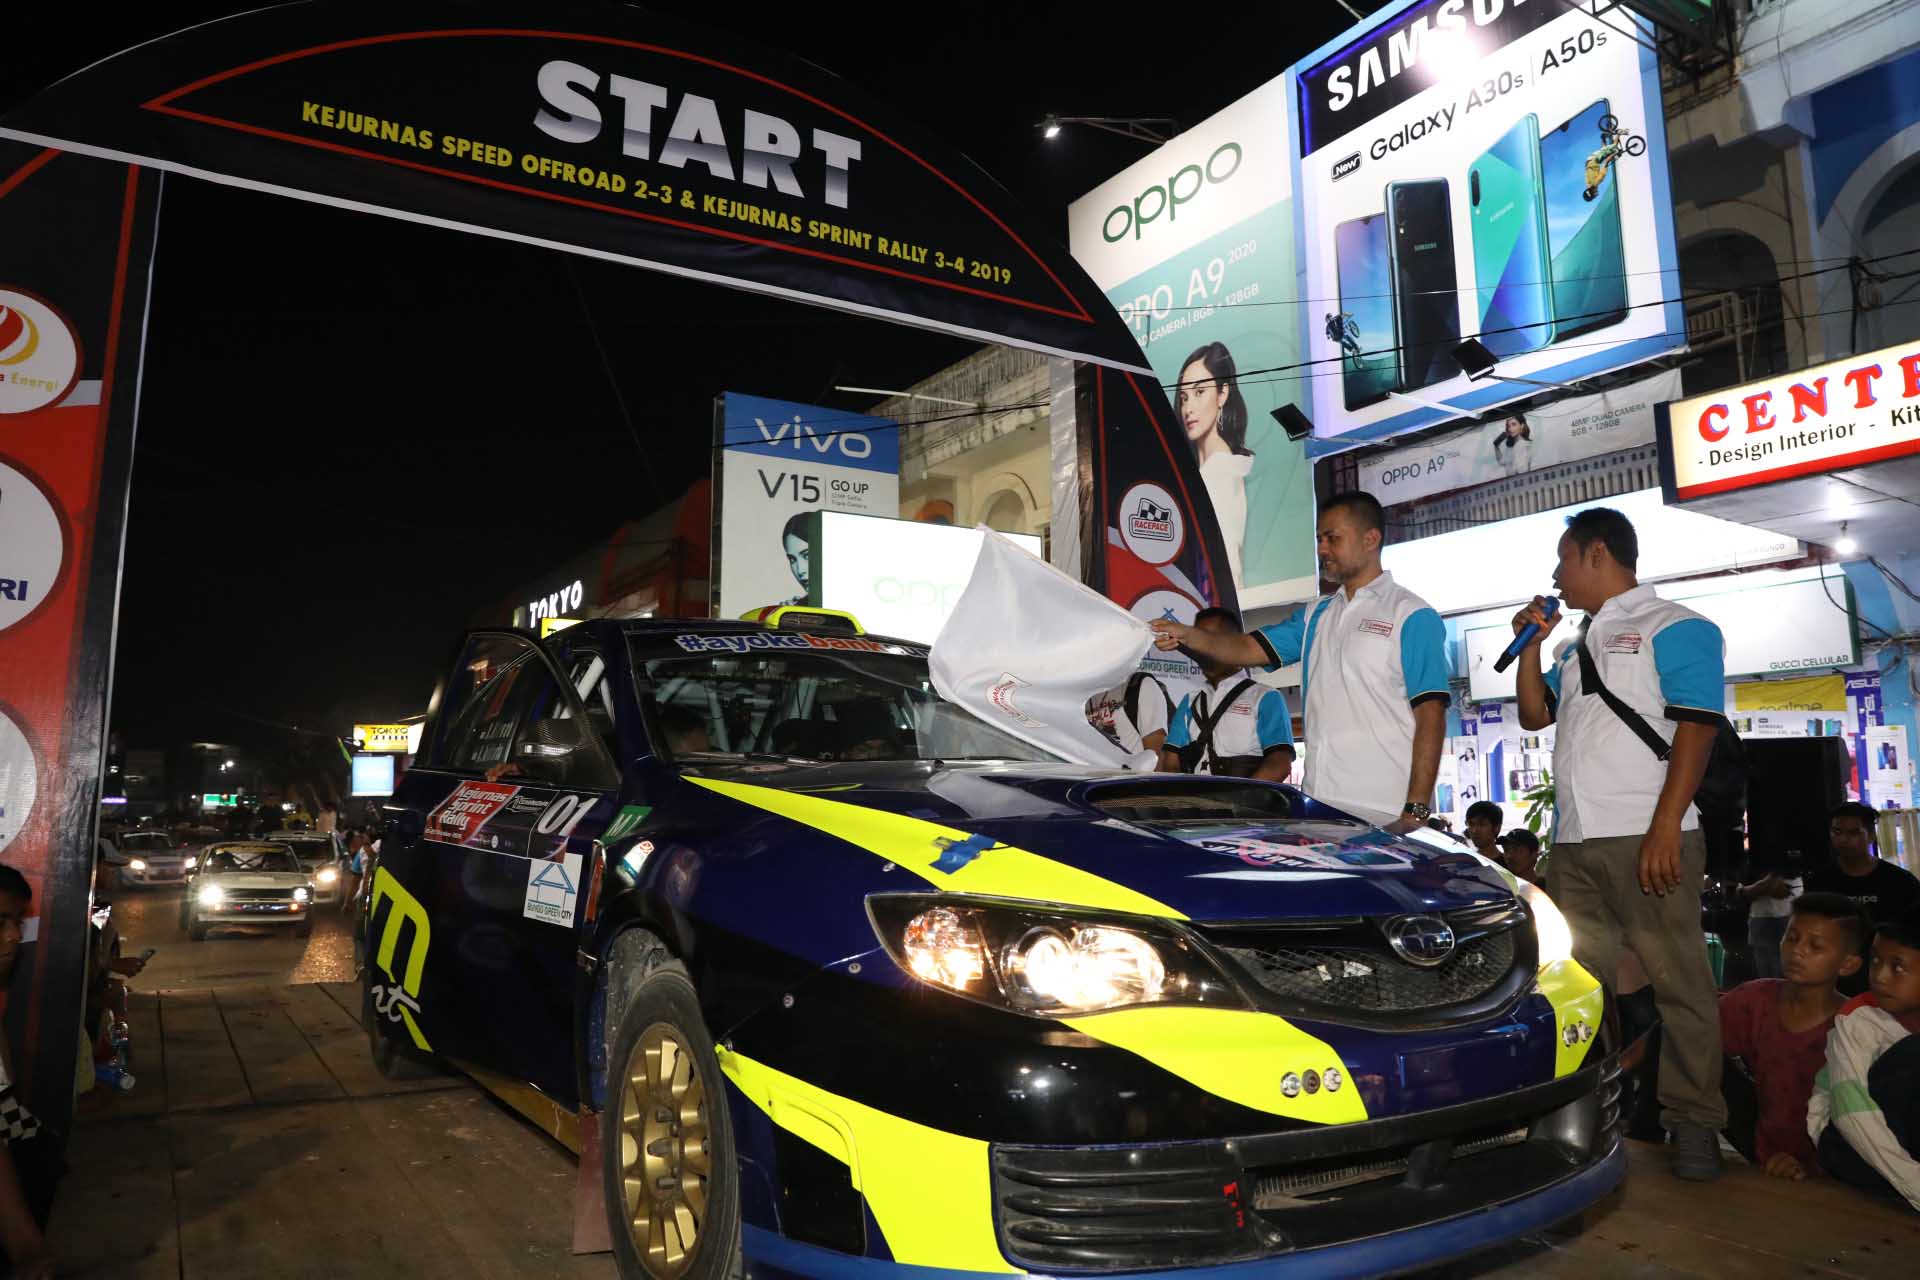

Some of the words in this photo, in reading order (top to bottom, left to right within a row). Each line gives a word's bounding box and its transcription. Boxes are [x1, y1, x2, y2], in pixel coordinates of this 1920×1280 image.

[1369, 102, 1457, 161] Galaxy
[1464, 70, 1524, 114] A30s
[1540, 28, 1608, 75] A50s
[533, 60, 862, 209] START
[1334, 158, 1361, 178] New
[302, 101, 433, 151] KEJURNAS
[441, 136, 513, 167] SPEED
[521, 154, 626, 194] OFFROAD
[634, 180, 674, 205] 2-3
[680, 191, 696, 210] &
[703, 194, 802, 234] KEJURNAS
[808, 219, 872, 252] SPRINT
[877, 236, 929, 266] RALLY
[934, 250, 966, 274] 3-4
[971, 258, 1012, 285] 2019
[1102, 142, 1243, 244] oppo
[1186, 257, 1225, 307] A9
[1150, 317, 1187, 342] CAMERA
[1614, 402, 1647, 417] CAMERA
[755, 415, 872, 459] vivo
[1709, 441, 1773, 467] Design
[1780, 422, 1857, 451] Interior
[1382, 463, 1421, 485] OPPO
[1427, 455, 1445, 474] A9
[757, 469, 821, 503] V15
[831, 479, 850, 492] GO
[853, 482, 869, 494] UP
[1135, 520, 1169, 532] RACEPACE
[529, 579, 584, 628] TOKYO
[1163, 663, 1189, 673] GREEN
[1769, 660, 1801, 670] GUCCI
[1802, 654, 1849, 668] CELLULAR
[371, 727, 408, 735] TOKYO
[448, 797, 493, 814] Sprint
[455, 786, 508, 802] Kejurnas
[439, 809, 471, 831] Rally
[537, 794, 600, 837] 01
[561, 910, 573, 921] CITY
